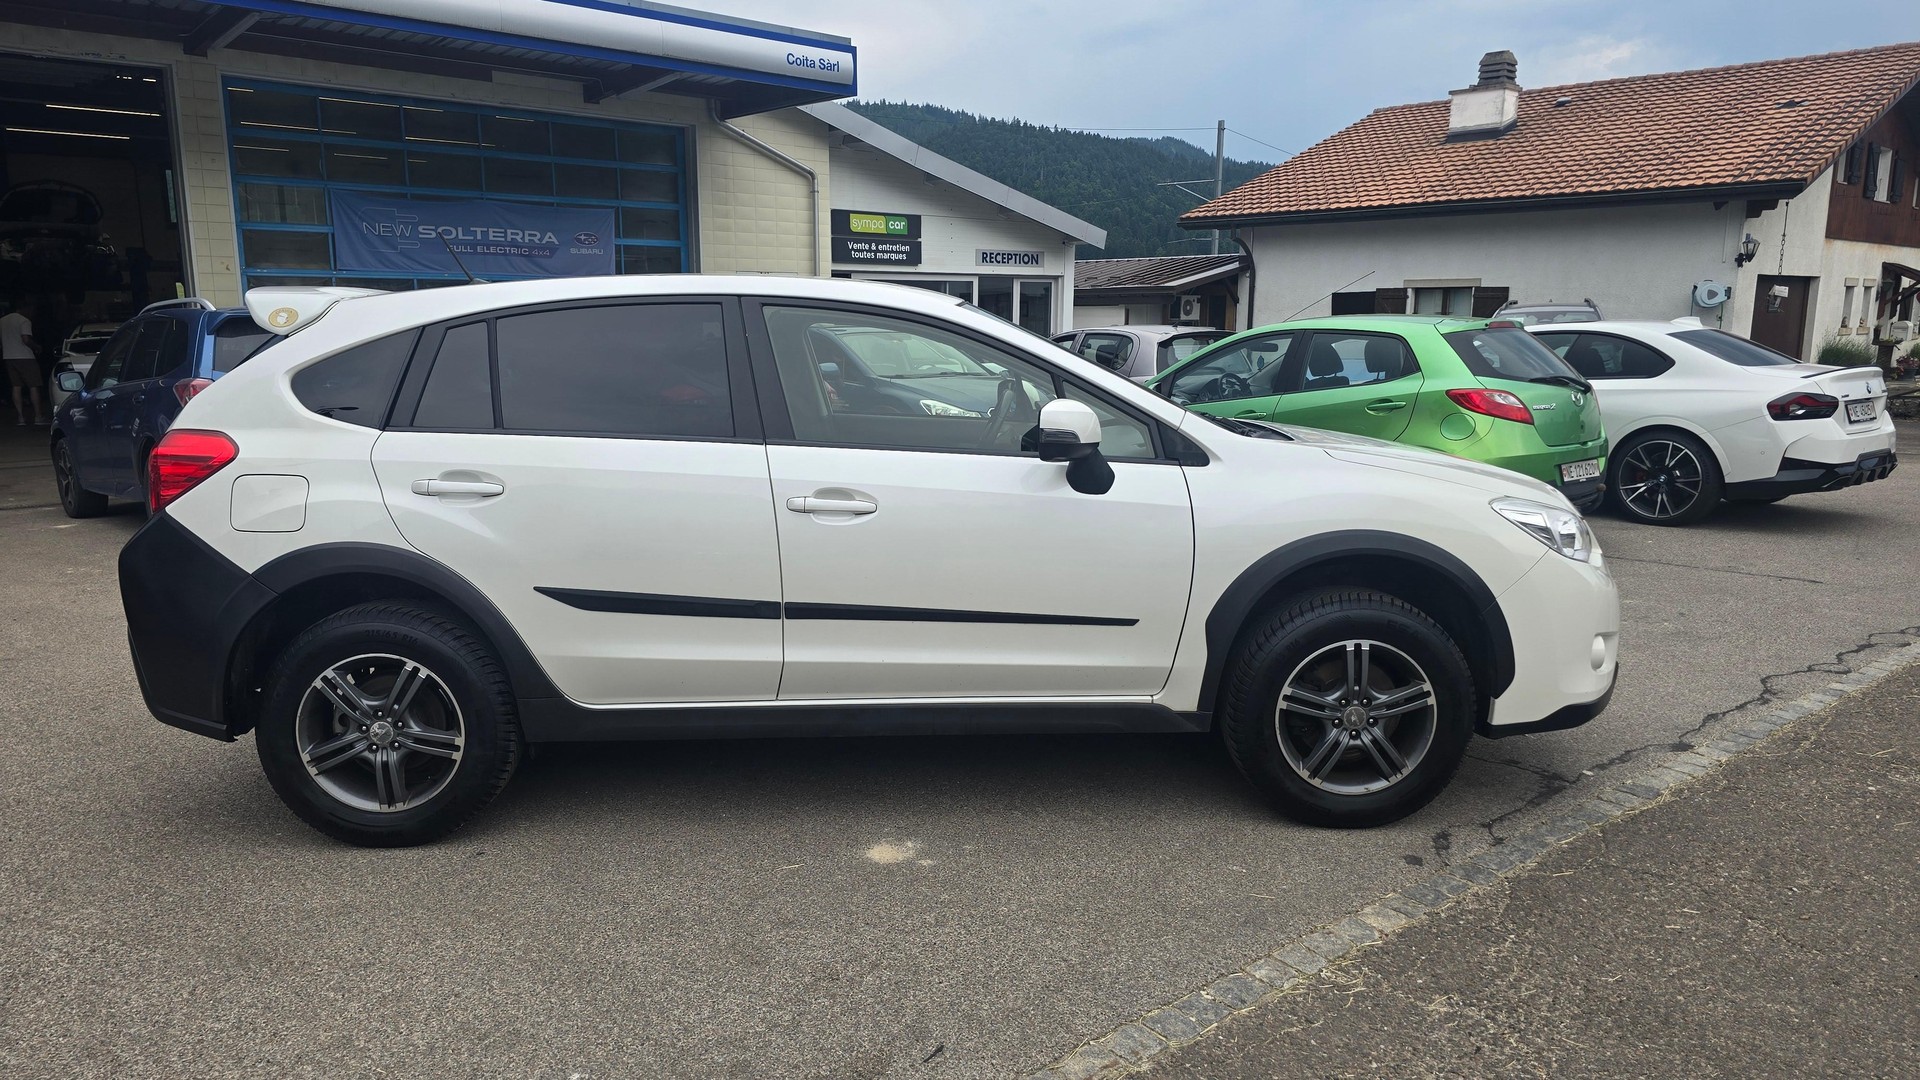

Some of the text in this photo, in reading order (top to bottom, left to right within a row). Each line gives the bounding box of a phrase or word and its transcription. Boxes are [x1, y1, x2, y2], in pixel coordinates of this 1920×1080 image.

[786, 53, 840, 73] Coita Sàrl
[852, 218, 906, 230] sympa car
[363, 222, 559, 245] NEW SOLTERRA
[477, 245, 529, 255] ELECTRIC
[569, 247, 604, 255] SUBARU
[847, 241, 910, 252] Vente & entretien
[851, 250, 907, 261] toutes marques
[981, 252, 1039, 265] RECEPTION
